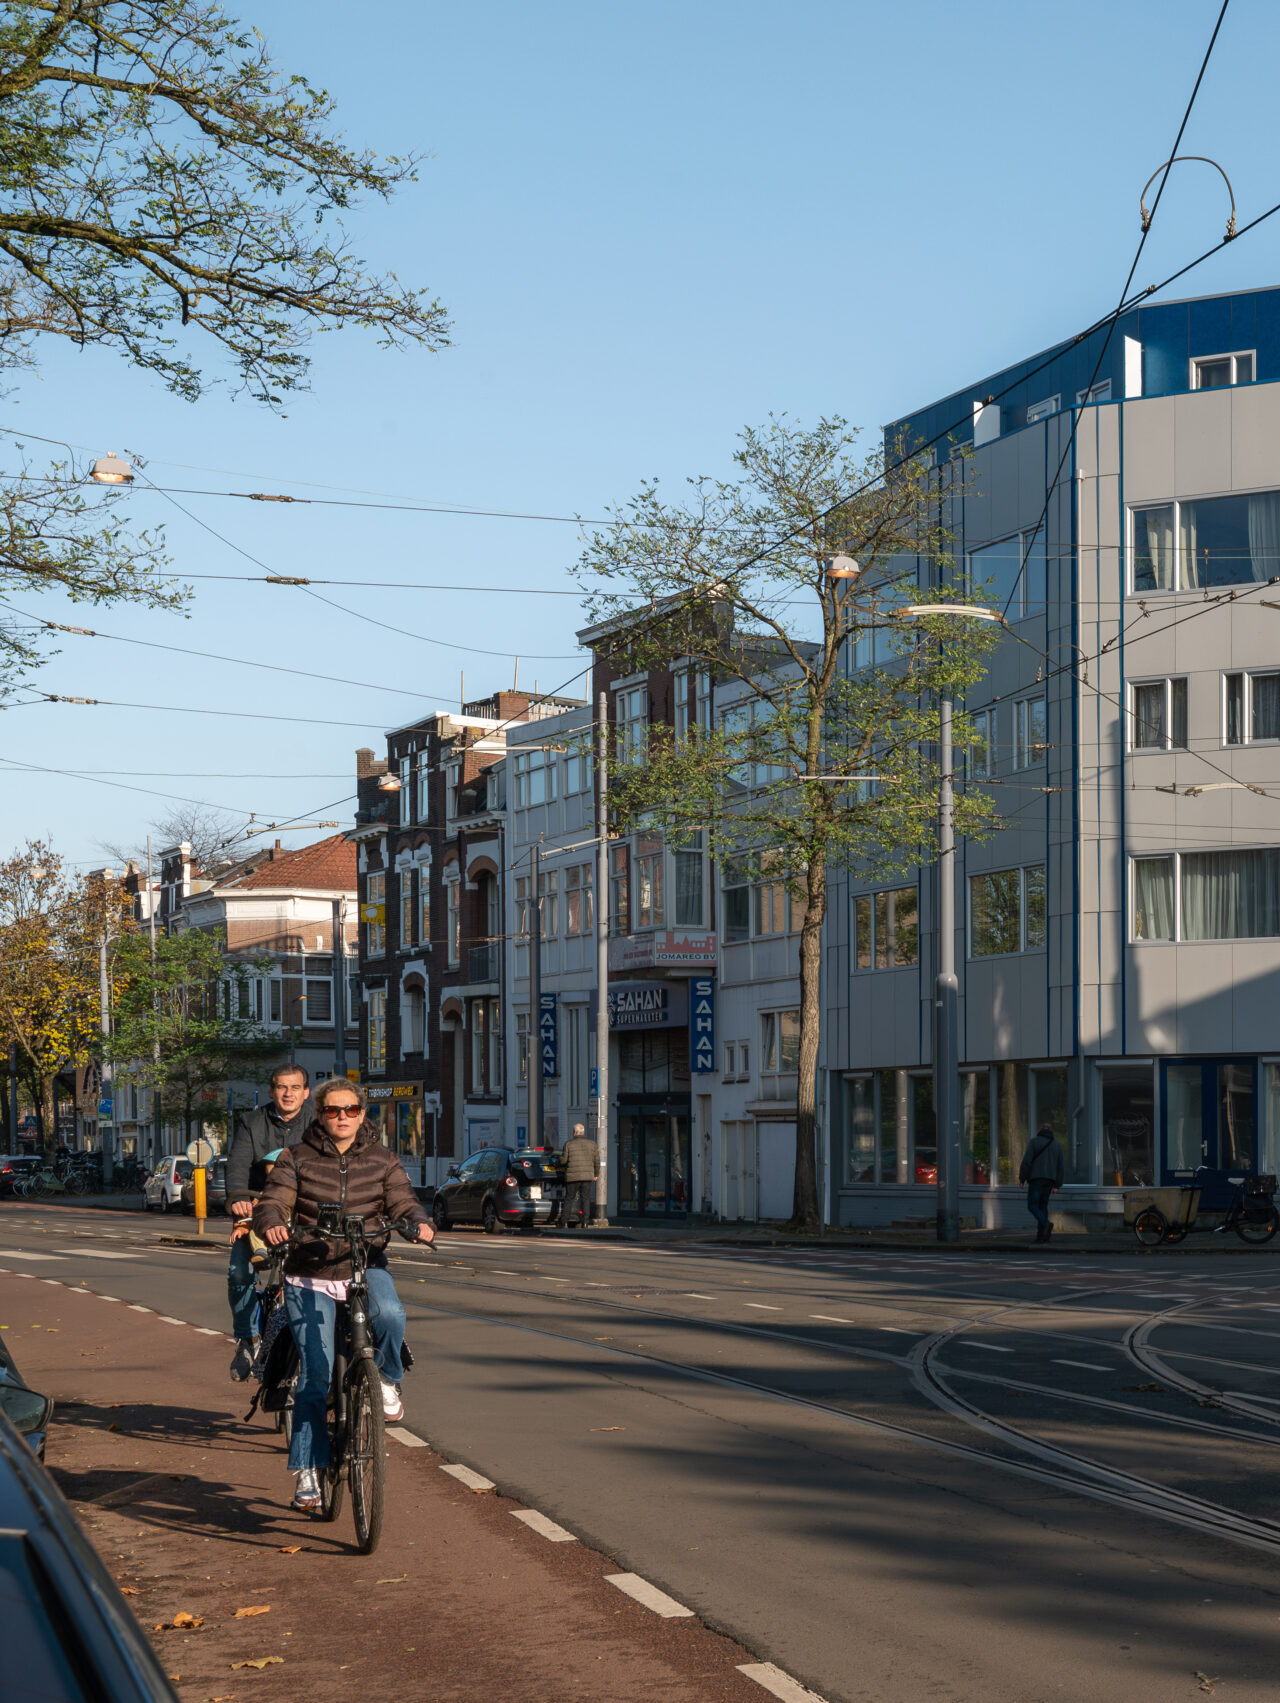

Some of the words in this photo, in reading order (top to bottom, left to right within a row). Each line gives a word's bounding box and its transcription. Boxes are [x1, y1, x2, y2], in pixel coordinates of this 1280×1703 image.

[540, 996, 555, 1075] SAHAN
[617, 988, 662, 1012] SAHAN
[696, 981, 713, 1069] SAHAN
